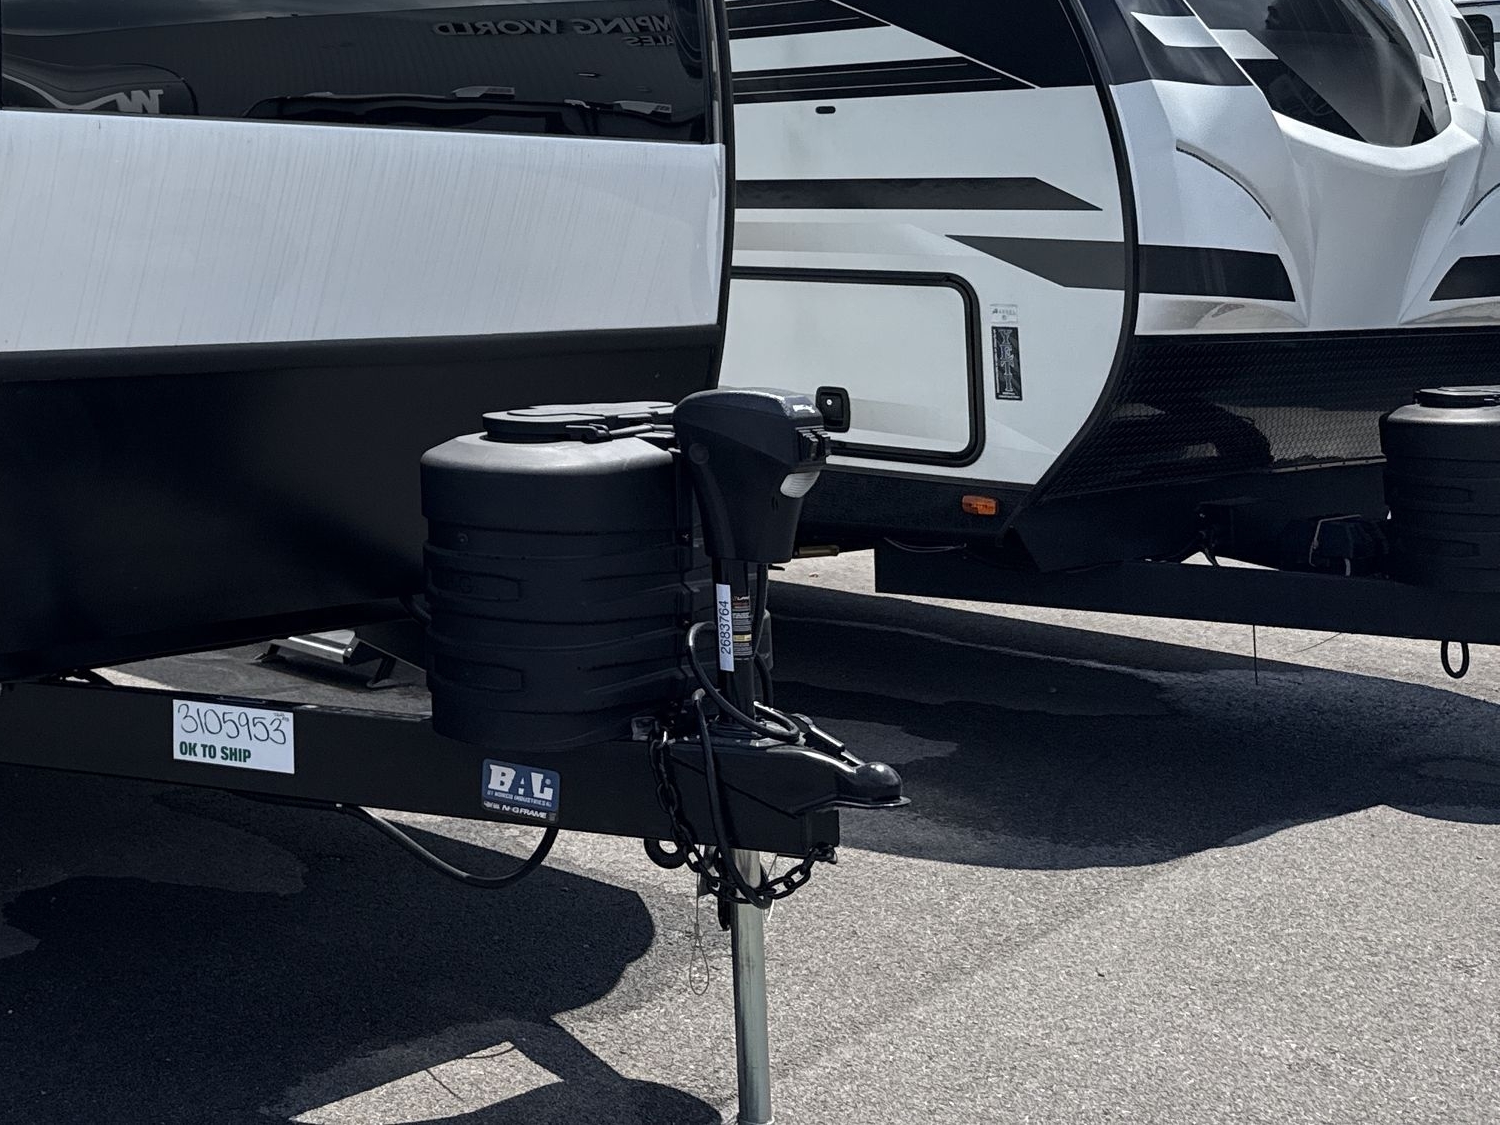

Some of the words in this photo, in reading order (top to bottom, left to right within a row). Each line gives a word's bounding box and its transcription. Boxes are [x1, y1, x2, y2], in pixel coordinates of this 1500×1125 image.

[999, 329, 1015, 392] YETI
[719, 600, 731, 655] 2683764
[177, 703, 287, 745] 3105953
[179, 740, 198, 757] OK
[200, 743, 217, 759] TO
[220, 745, 252, 763] SHIP
[488, 764, 554, 801] BAL
[519, 807, 548, 819] FRAME
